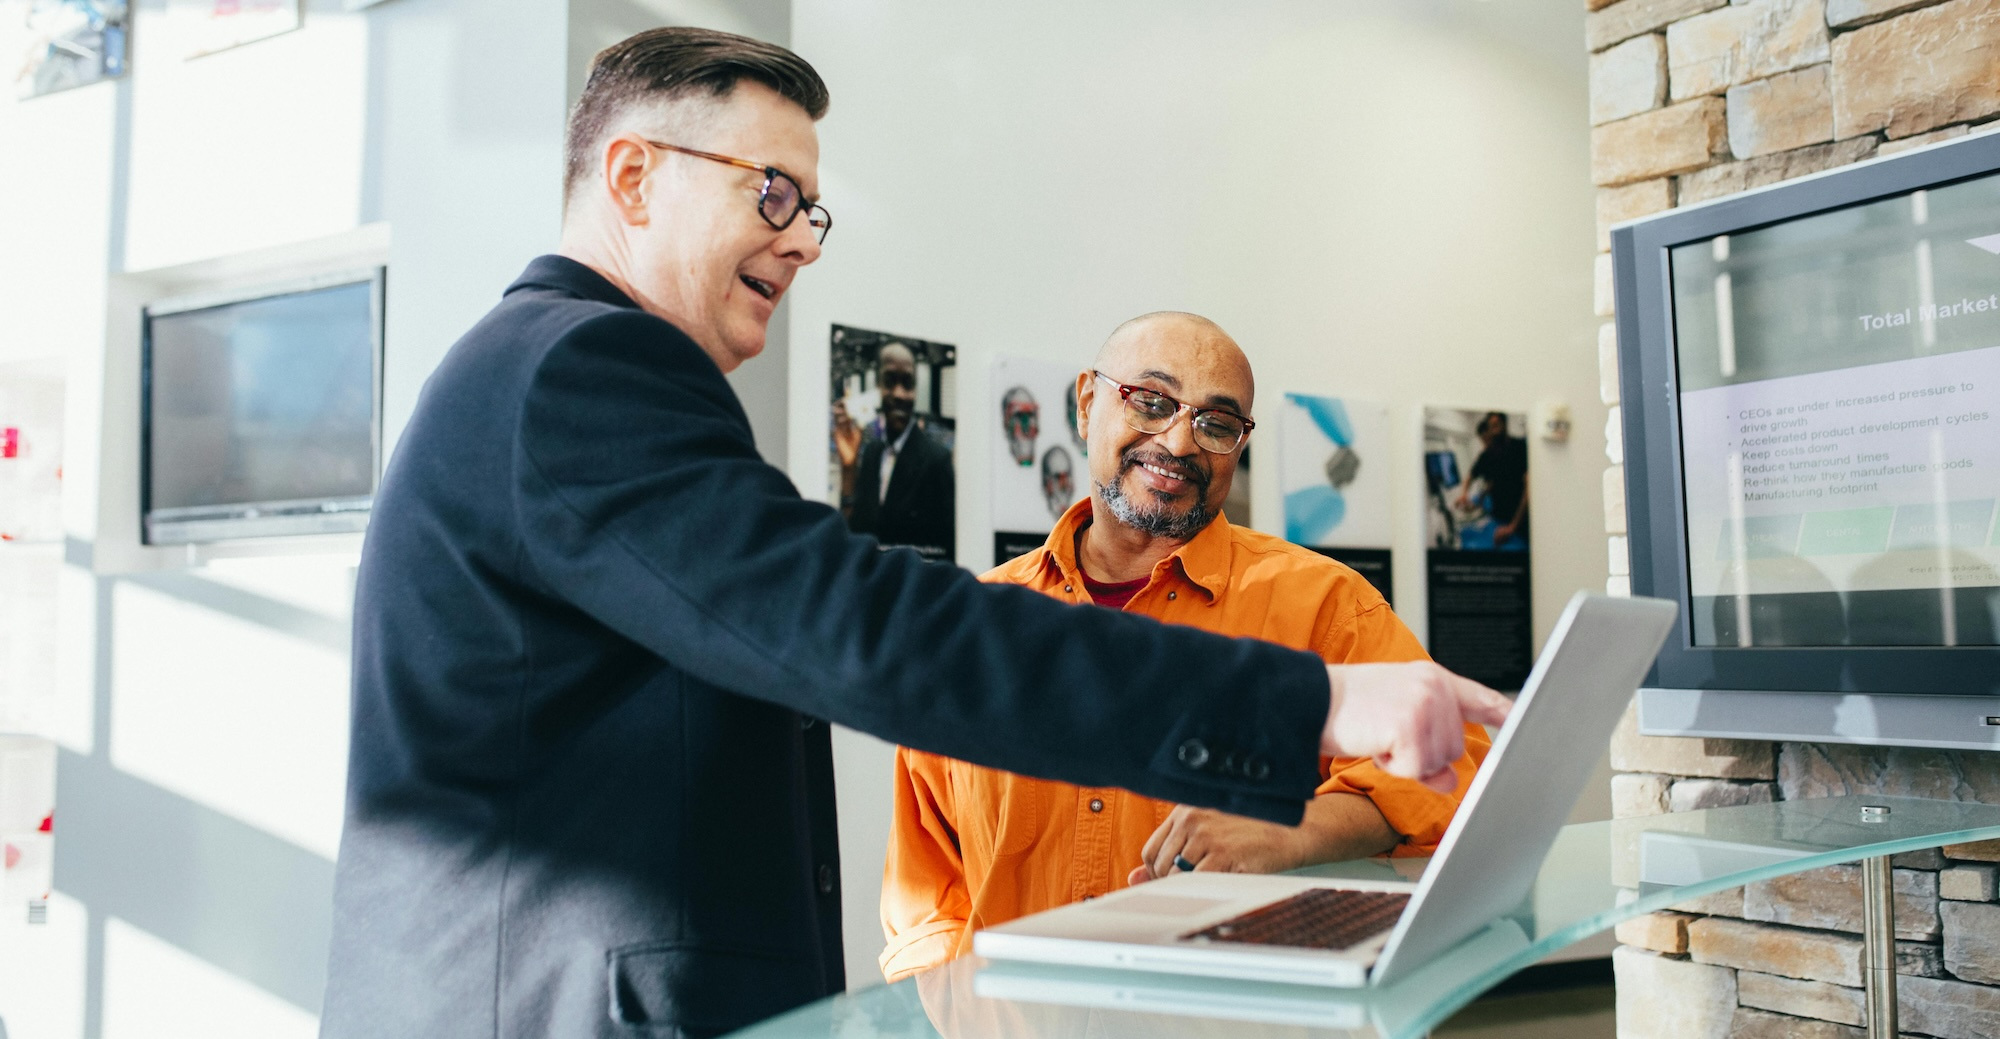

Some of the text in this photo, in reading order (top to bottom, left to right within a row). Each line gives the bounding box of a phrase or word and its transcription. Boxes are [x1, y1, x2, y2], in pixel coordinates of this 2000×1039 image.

[1859, 294, 1998, 331] Total Market
[1739, 382, 1974, 420] CEOs are under increased pressure to
[1740, 417, 1808, 434] drive growth
[1741, 411, 1990, 447] Accelerated product development cycles
[1742, 443, 1839, 461] Keep costs down
[1743, 452, 1890, 475] Reduce turnaround times
[1744, 458, 1974, 488] Re-think how they manufacture goods
[1744, 482, 1878, 502] Manufacturing footprint
